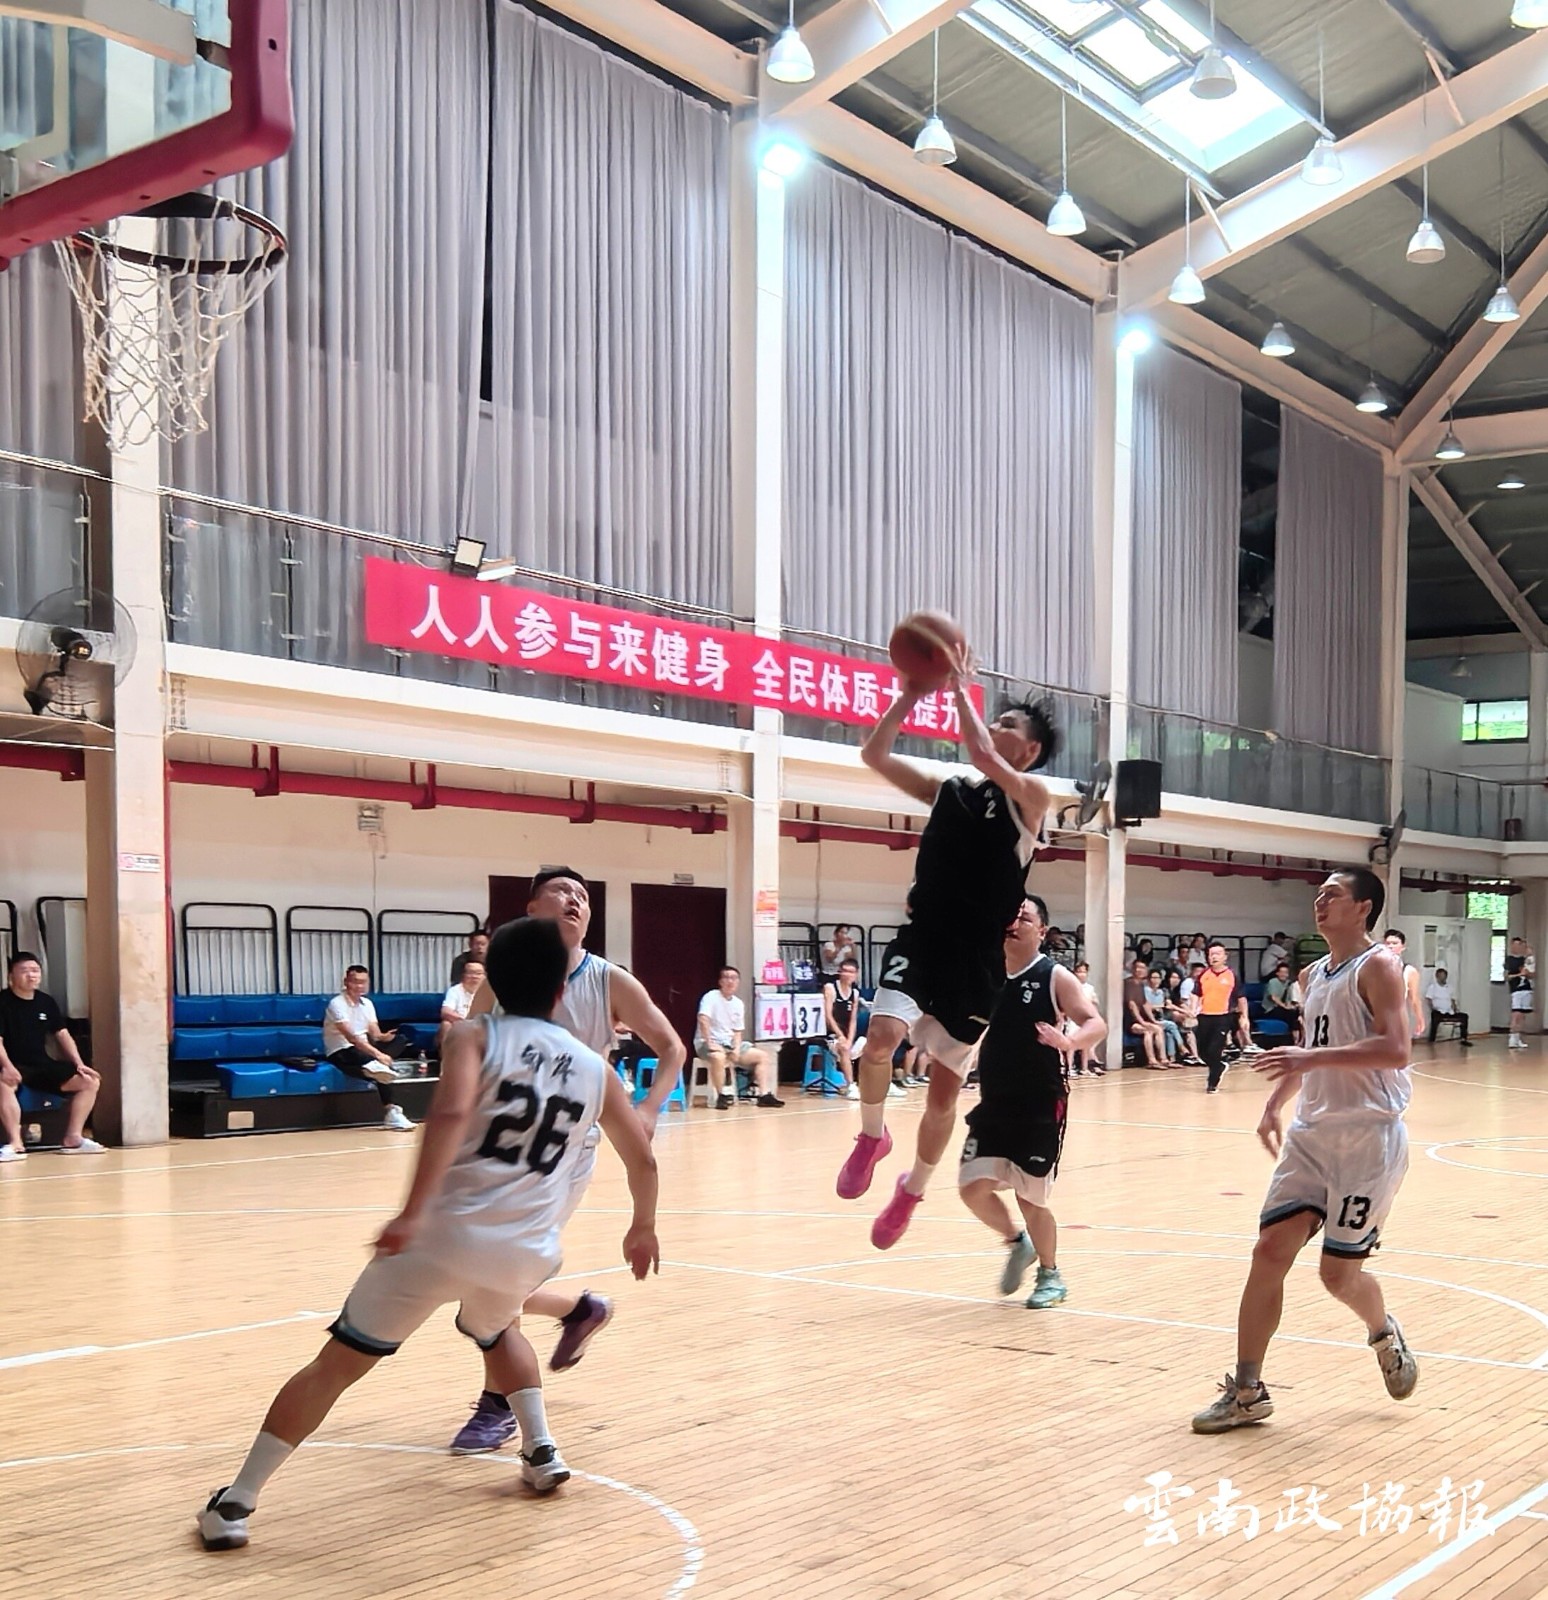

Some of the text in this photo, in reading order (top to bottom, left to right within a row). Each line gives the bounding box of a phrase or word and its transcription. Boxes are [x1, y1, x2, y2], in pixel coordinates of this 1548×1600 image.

[410, 584, 731, 692] 人人参与来健身
[984, 799, 996, 819] 2
[883, 955, 910, 983] 2
[763, 1007, 789, 1036] 44
[799, 1006, 822, 1034] 37
[1311, 1014, 1330, 1048] 13
[473, 1079, 586, 1176] 26
[1337, 1194, 1371, 1230] 13
